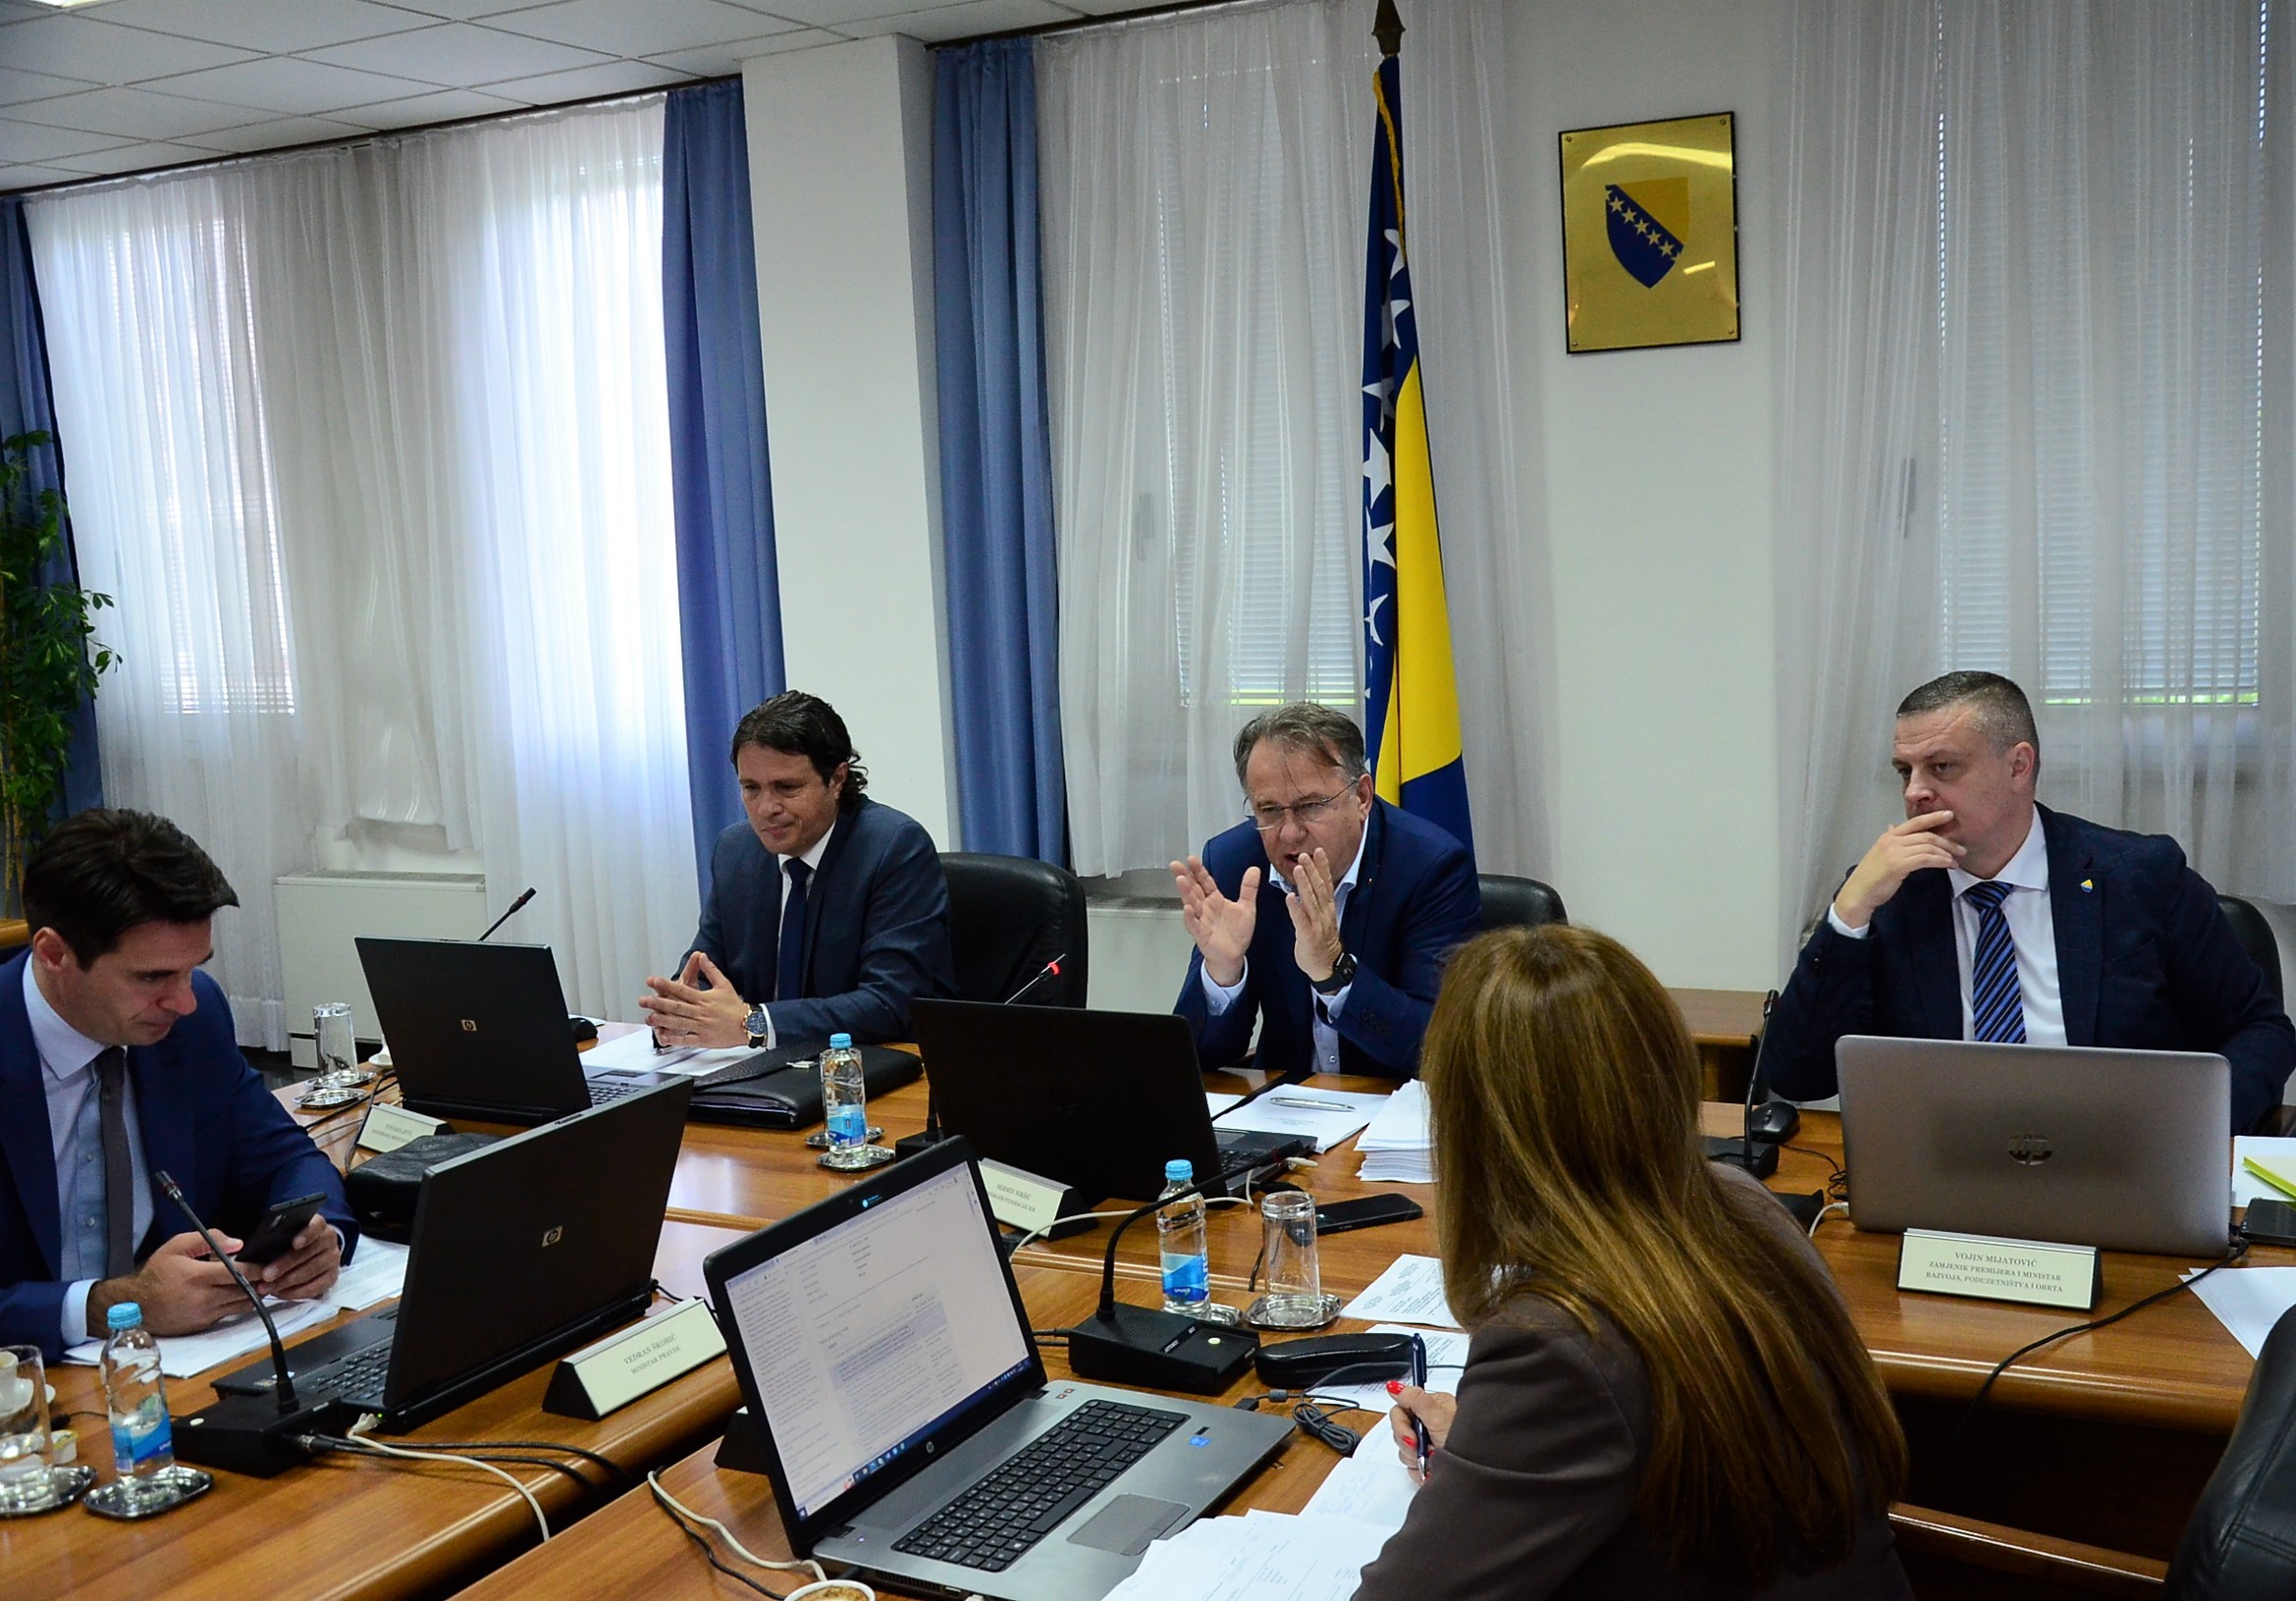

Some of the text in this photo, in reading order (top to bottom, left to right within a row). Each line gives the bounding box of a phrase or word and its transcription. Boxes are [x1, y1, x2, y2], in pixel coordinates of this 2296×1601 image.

[1954, 1252, 2038, 1267] VOJIN MIJATOVIĆ
[1929, 1261, 1969, 1272] ZAMJENIK
[1970, 1265, 2016, 1277] PREMIJERA
[2022, 1271, 2062, 1282] MINISTAR
[1964, 1275, 2030, 1289] PODUZETNIŠTVA
[2036, 1284, 2063, 1293] OBRTA
[623, 1347, 652, 1364] VEDRAN
